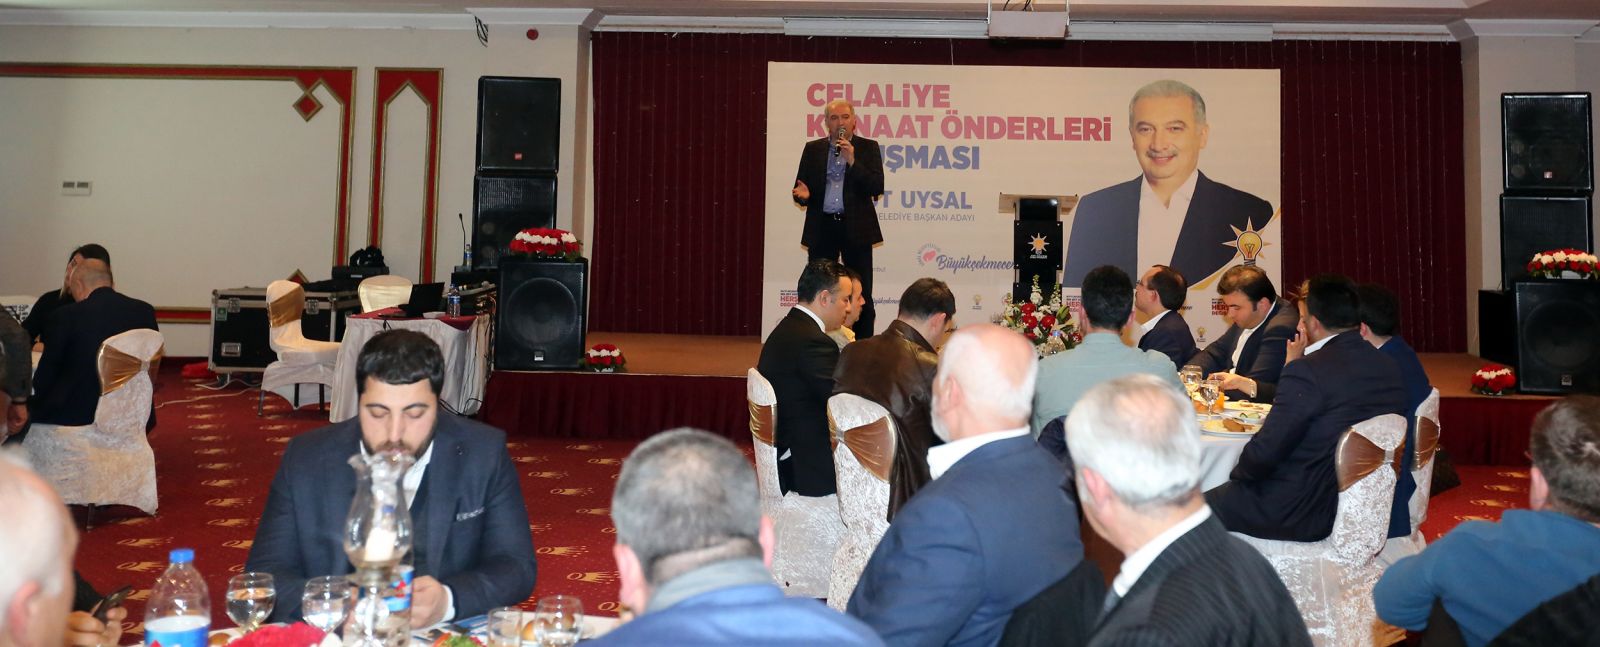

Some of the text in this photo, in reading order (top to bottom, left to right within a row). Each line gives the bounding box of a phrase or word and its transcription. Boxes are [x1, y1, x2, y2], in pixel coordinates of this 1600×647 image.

[807, 83, 950, 108] CELALİYE
[807, 110, 1112, 141] KNAAT ÖNDERLERİ
[900, 190, 973, 209] UYSAL
[878, 212, 975, 222] ELEDİYE BAŞKAN ADAYI
[935, 254, 1014, 274] Büyükçekmece
